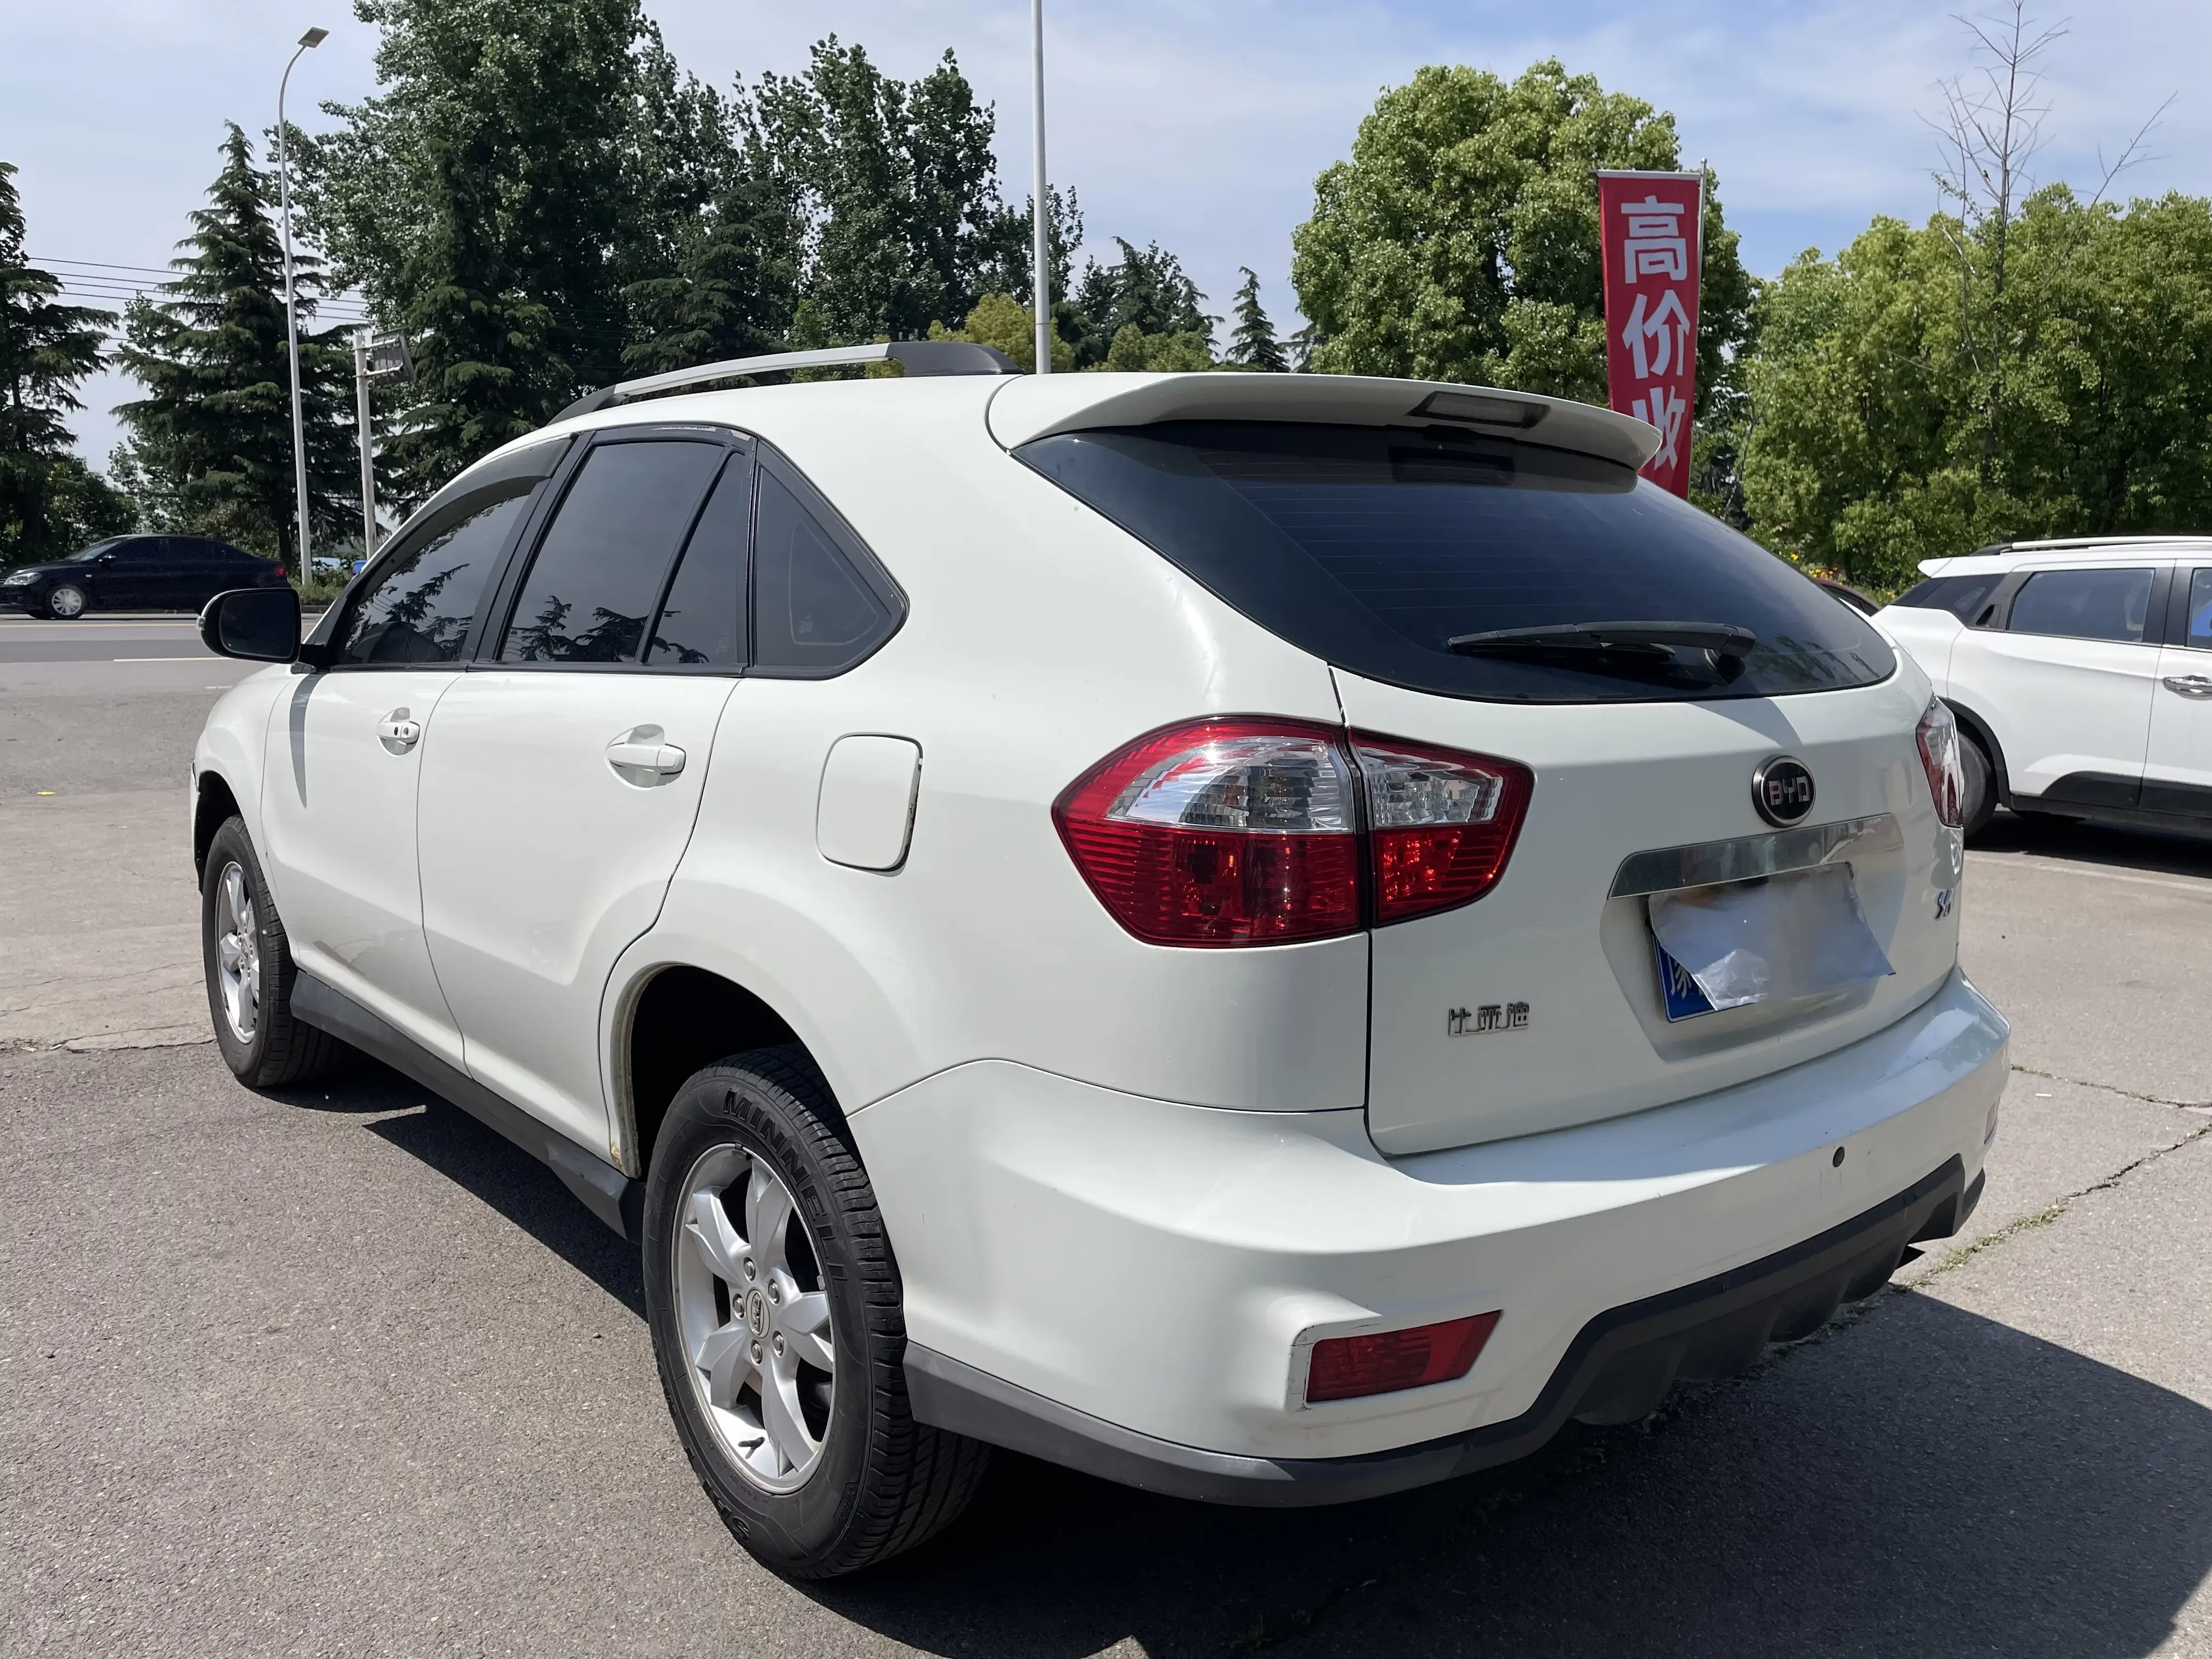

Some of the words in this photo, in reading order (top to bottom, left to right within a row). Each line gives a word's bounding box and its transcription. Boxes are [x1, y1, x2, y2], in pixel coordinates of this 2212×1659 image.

[1621, 195, 1691, 471] 高价收
[1768, 776, 1810, 805] BYD
[1935, 890, 1952, 921] S6
[1448, 1001, 1530, 1037] 比亚迪
[722, 1088, 848, 1298] MINNELL
